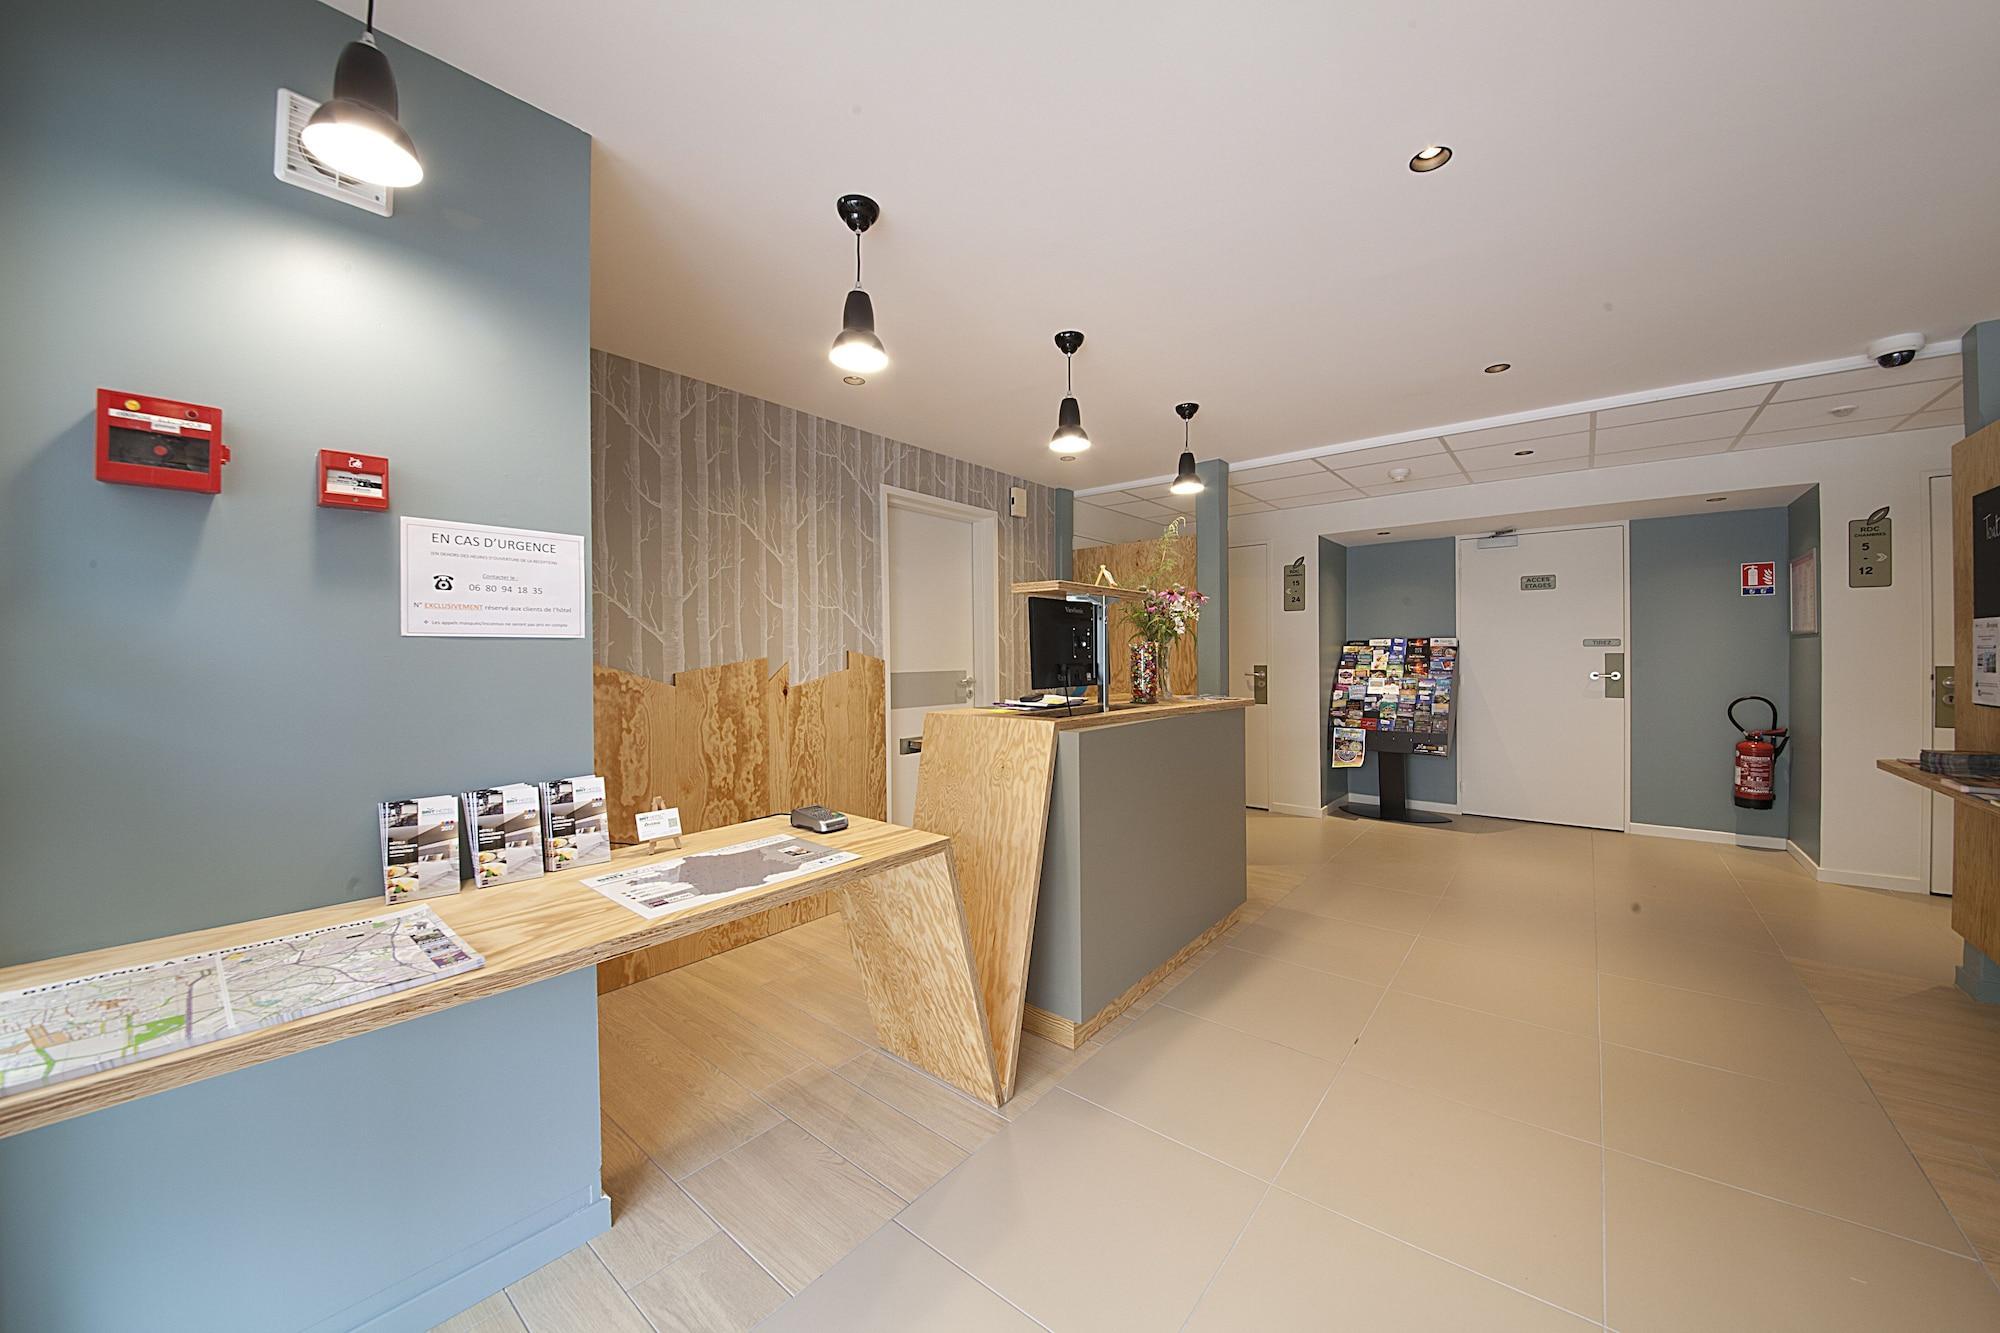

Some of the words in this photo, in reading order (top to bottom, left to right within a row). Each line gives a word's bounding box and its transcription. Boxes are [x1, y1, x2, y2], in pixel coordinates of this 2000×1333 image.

[1860, 525, 1880, 533] RDC
[431, 532, 450, 544] EN
[454, 535, 480, 547] CAS
[1861, 542, 1870, 551] 5
[1858, 566, 1874, 575] 12
[532, 587, 543, 595] 35
[424, 603, 483, 611] EXCLUSIVEMENT
[22, 965, 154, 995] BIENVENUE
